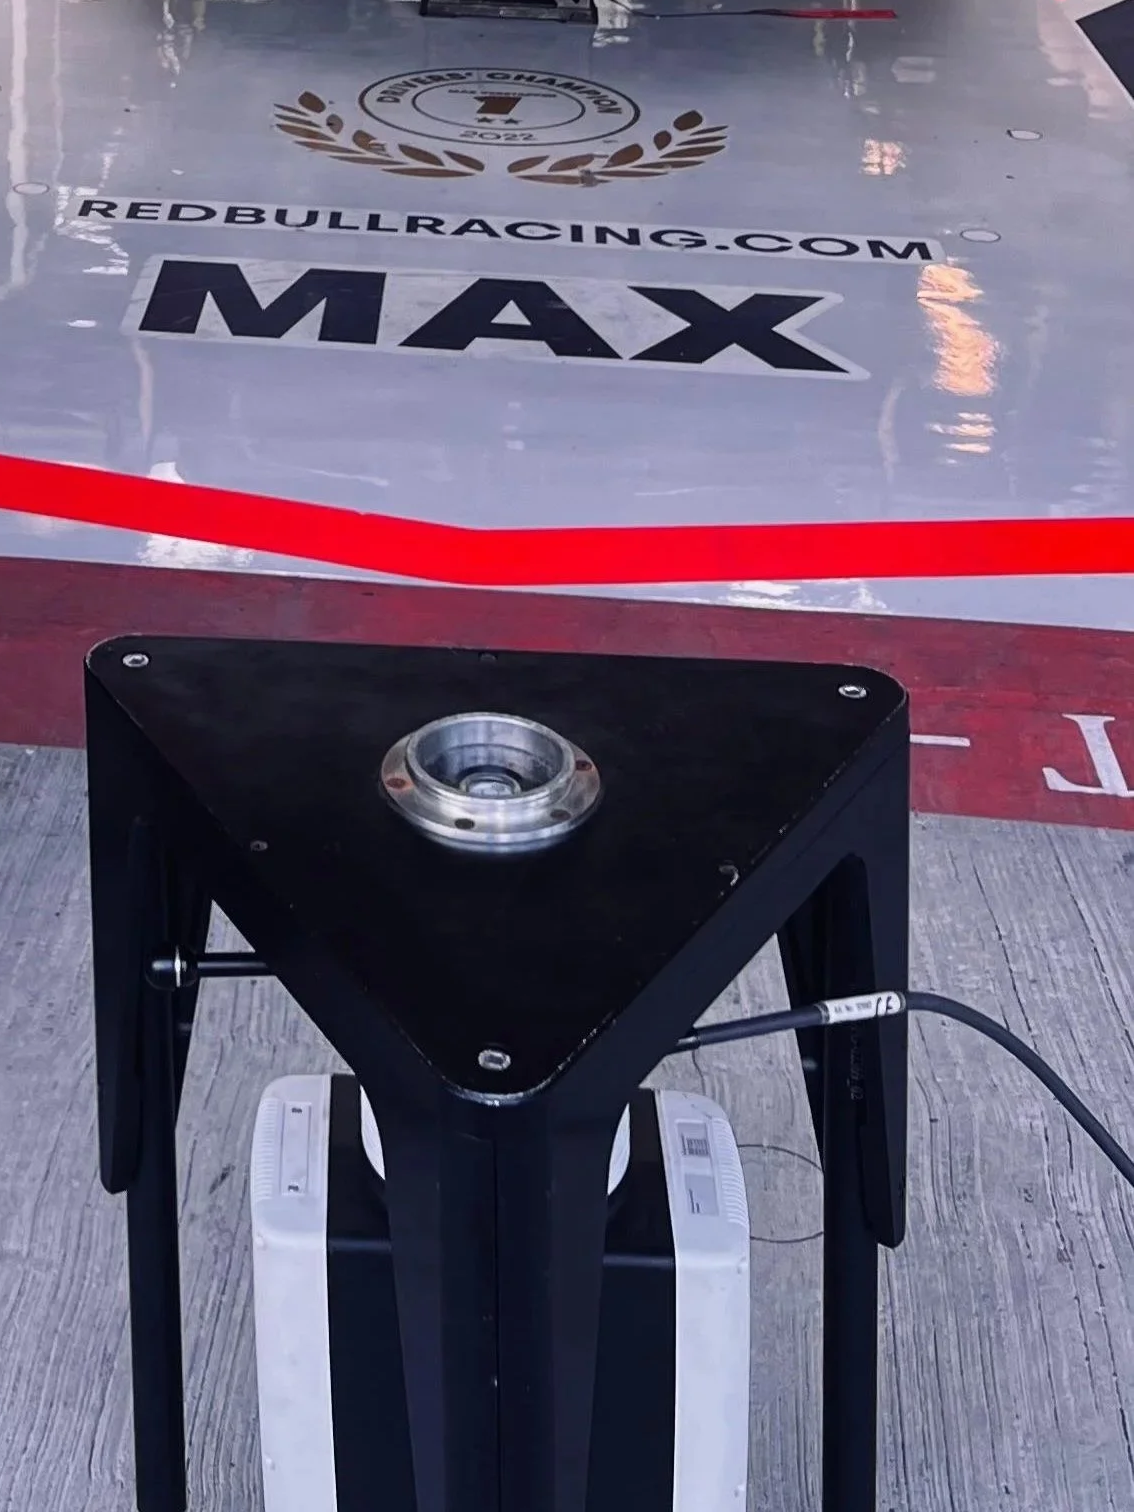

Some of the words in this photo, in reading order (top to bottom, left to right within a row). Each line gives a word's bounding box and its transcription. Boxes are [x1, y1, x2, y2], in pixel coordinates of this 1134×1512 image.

[473, 96, 522, 115] 1
[485, 71, 623, 115] CHAMPION
[459, 130, 539, 141] 2022
[78, 199, 933, 261] REDBULLRACING.COM
[138, 259, 851, 374] MAX
